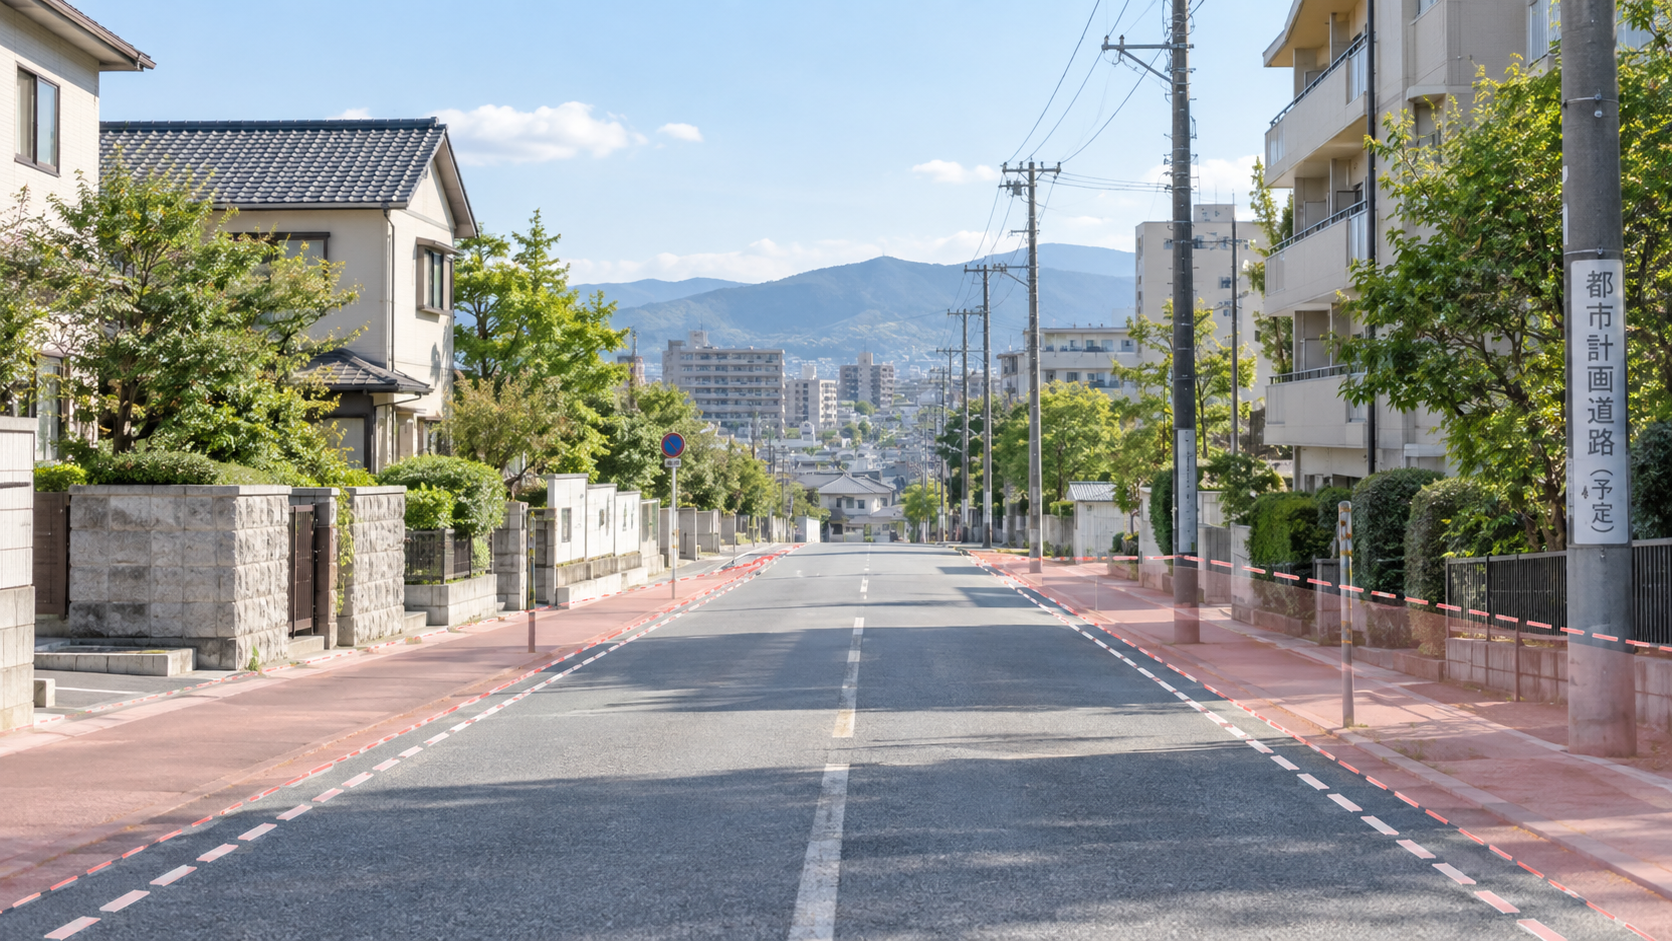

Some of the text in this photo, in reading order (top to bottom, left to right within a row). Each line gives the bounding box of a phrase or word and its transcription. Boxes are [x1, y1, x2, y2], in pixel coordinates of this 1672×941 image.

[1586, 270, 1615, 533] 都市計画道路（予定）
